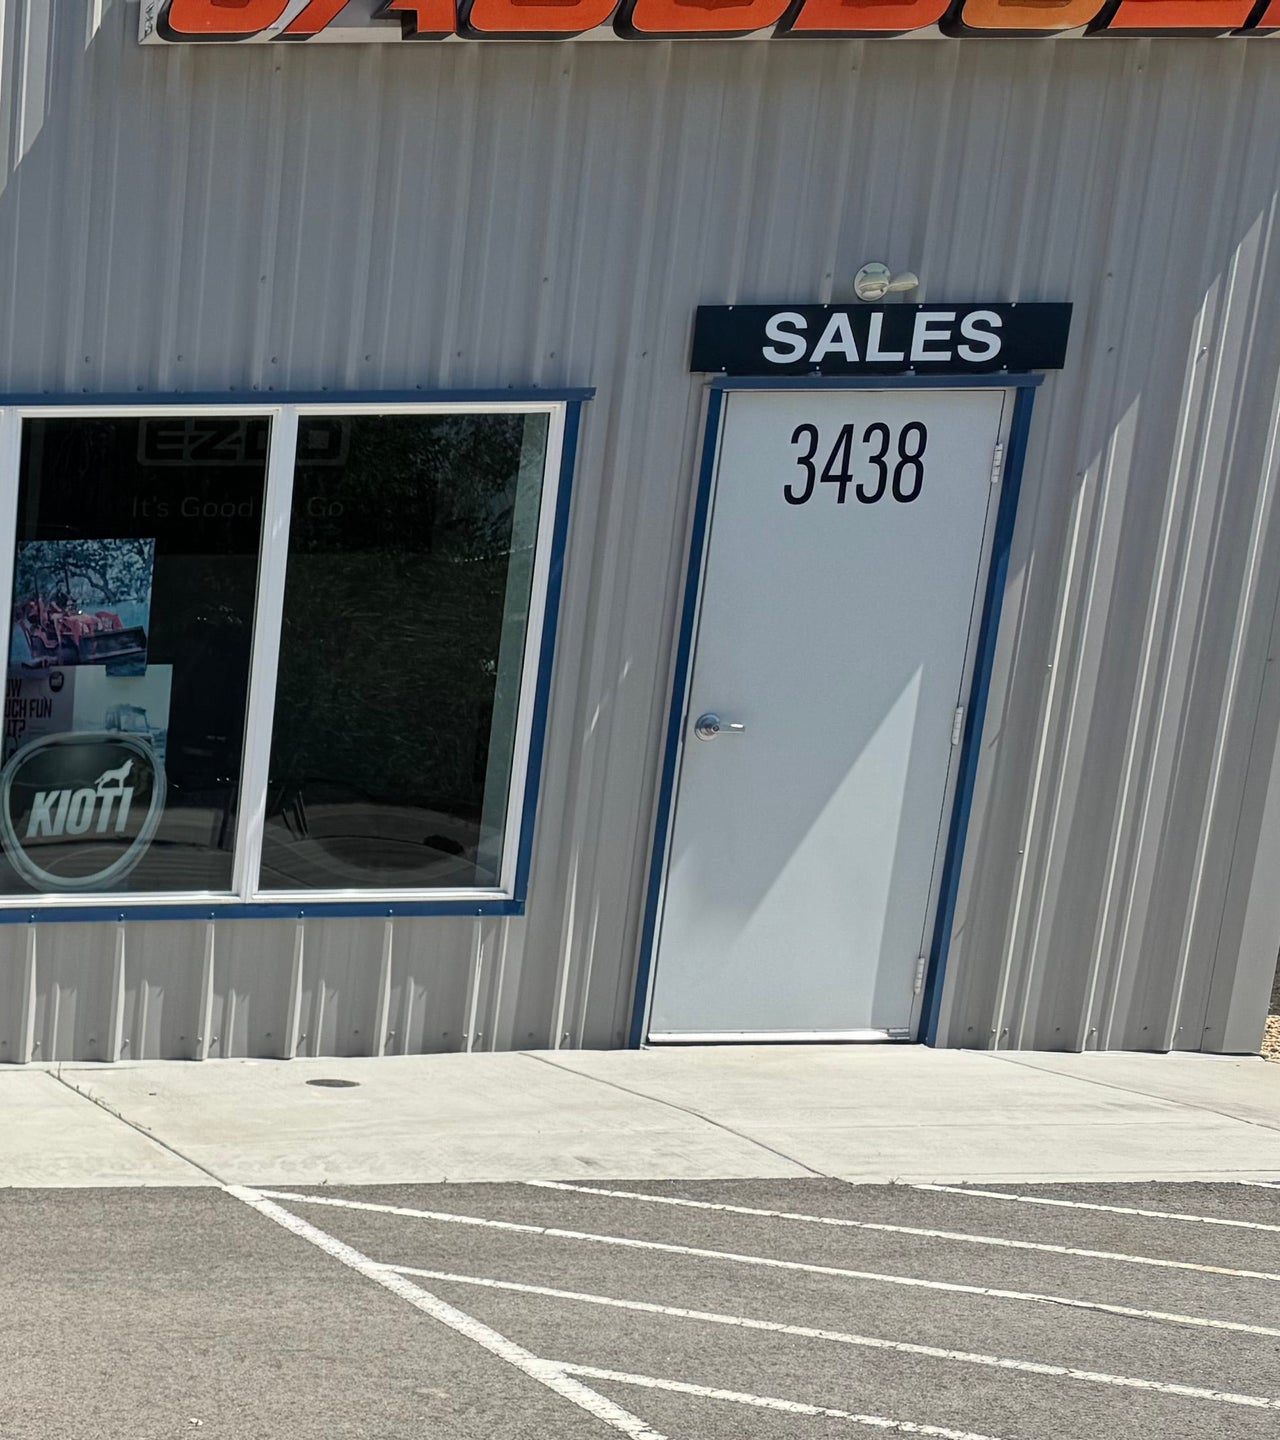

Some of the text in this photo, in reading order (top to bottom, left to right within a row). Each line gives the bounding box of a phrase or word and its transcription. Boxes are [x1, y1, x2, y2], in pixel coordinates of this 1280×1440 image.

[762, 310, 1003, 364] SALES
[783, 420, 928, 506] 3438
[131, 495, 344, 519] It's Good Go
[5, 698, 53, 718] UCH FUN
[26, 787, 135, 838] KIOTI
